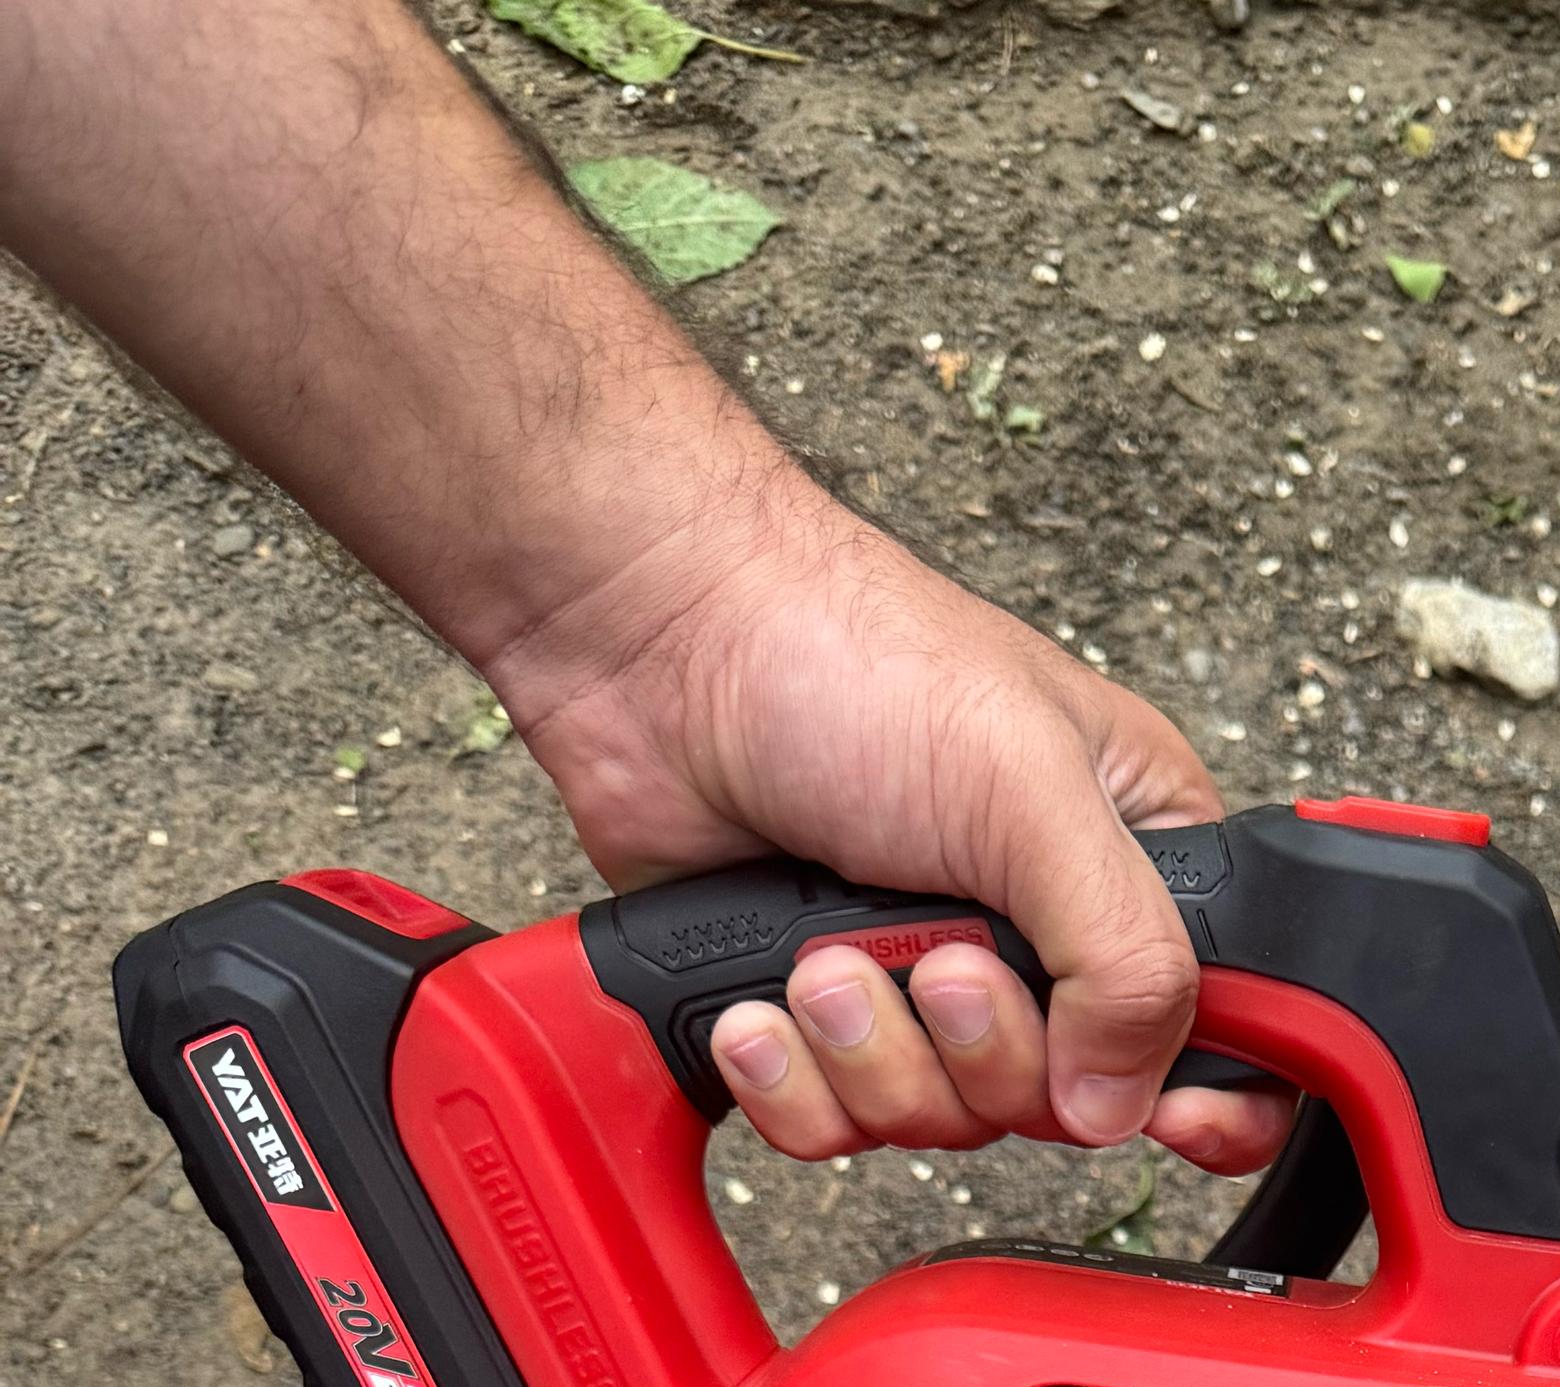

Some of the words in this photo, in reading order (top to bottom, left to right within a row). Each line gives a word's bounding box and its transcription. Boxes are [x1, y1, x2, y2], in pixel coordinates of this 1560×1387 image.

[816, 926, 985, 959] USHLESS
[212, 1048, 269, 1123] YAT
[247, 1123, 304, 1195] 亚特
[315, 1277, 419, 1379] 20V
